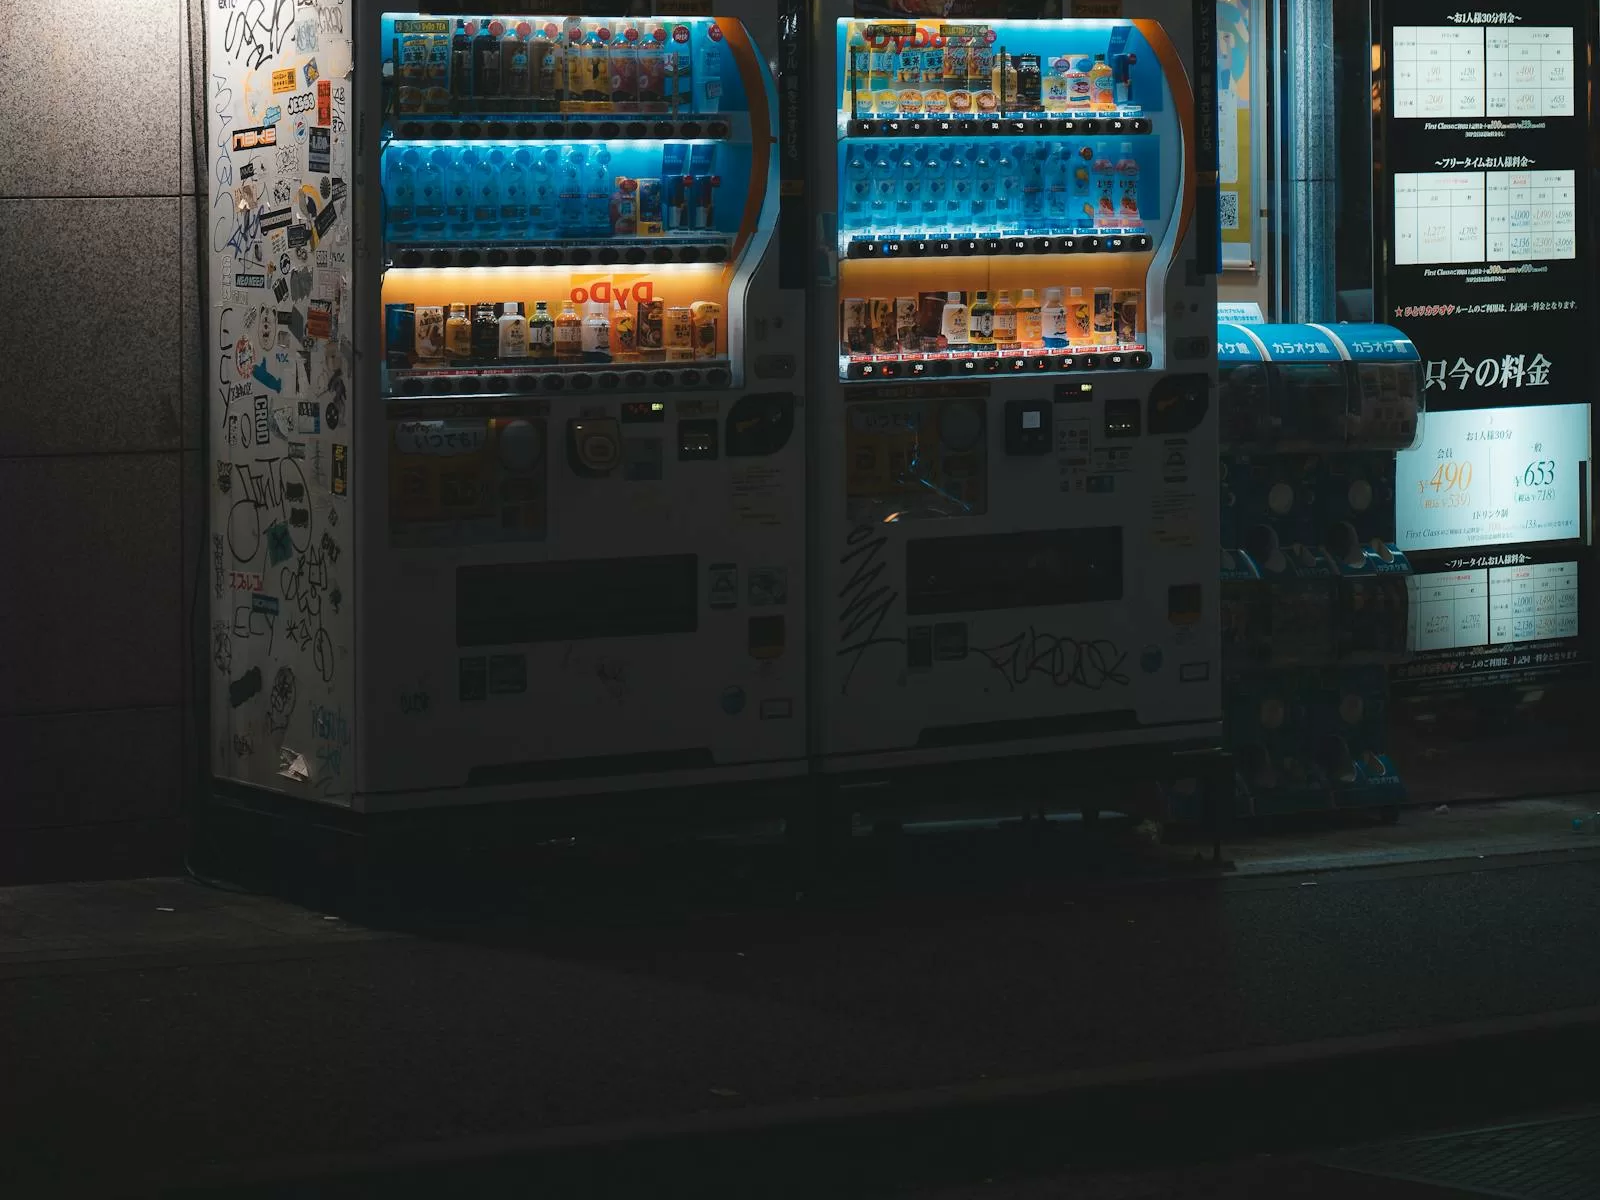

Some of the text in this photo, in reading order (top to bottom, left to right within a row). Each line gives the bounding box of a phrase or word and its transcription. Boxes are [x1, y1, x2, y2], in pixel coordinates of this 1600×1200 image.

[1272, 342, 1330, 354] カラオケ館
[1351, 341, 1408, 354] カラオケ館
[1424, 353, 1552, 391] 只今の料金
[1466, 430, 1513, 442] お1人様30分
[1437, 448, 1453, 459] 会員
[1418, 461, 1473, 494] ¥490
[1515, 460, 1555, 487] ¥653
[1405, 529, 1422, 540] First
